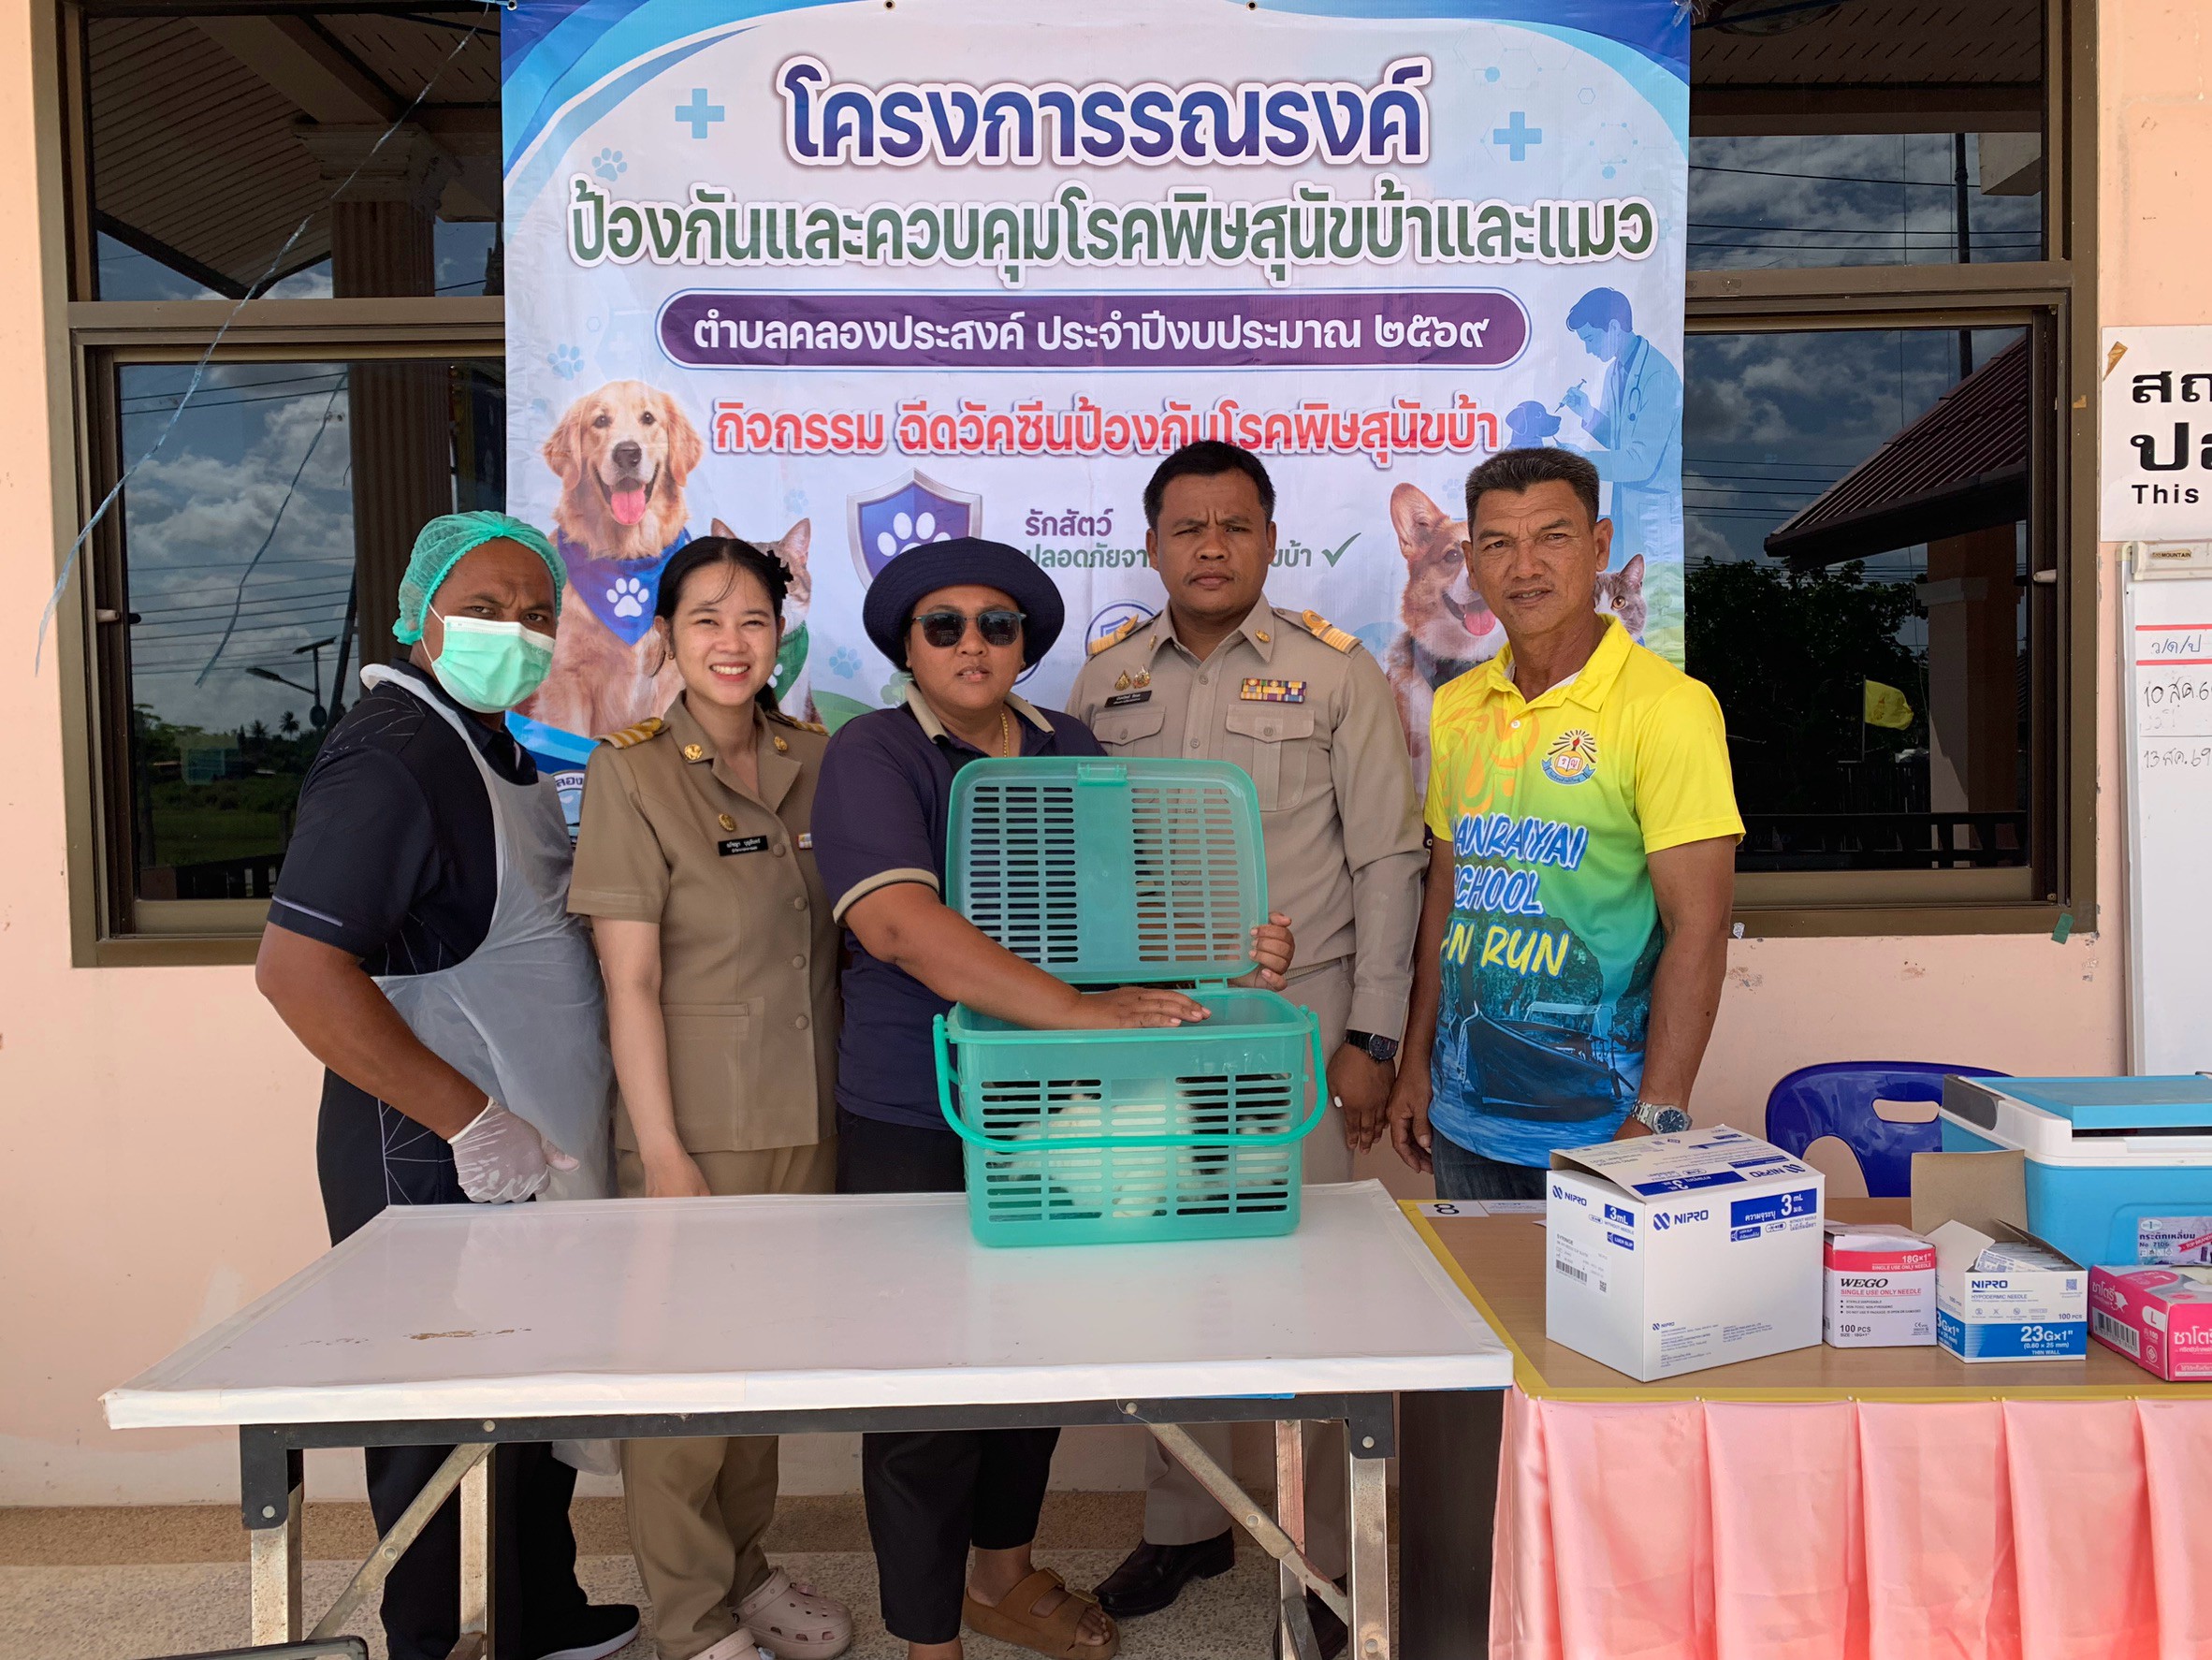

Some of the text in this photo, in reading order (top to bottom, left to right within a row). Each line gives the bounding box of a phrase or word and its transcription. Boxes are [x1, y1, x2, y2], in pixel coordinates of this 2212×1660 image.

[783, 63, 1423, 156] โครงการรณรงค์
[573, 179, 1653, 283] ป้องกันและควบคุมโรคพิษสุนัขบ้าและแมว
[693, 309, 1490, 350] ตำบลคลองประสงค์ ประจำปีงบประมาณ ๒๕๖๙
[716, 394, 1497, 463] กิจกรรม ฉีดวัคซีนป้องกันโรคพิษสุนัขบ้า
[2132, 484, 2200, 504] This
[1025, 508, 1113, 536] รักสัตว์
[2144, 686, 2163, 706] 10
[2199, 681, 2212, 701] 6
[1453, 811, 1589, 871] ANRAYAI
[1454, 865, 1545, 917] CHOOL
[1440, 923, 1570, 976] N RUN
[1750, 1167, 1783, 1178] NIPRO
[1564, 1191, 1587, 1207] NIPRO
[1781, 1194, 1793, 1216] 3
[1674, 1209, 1709, 1225] NIPRO
[2139, 1229, 2196, 1240] กระติกเหลี่ยม
[1841, 1278, 1888, 1288] WEGO
[1972, 1280, 2008, 1289] NIPRO
[1840, 1324, 1855, 1332] 100
